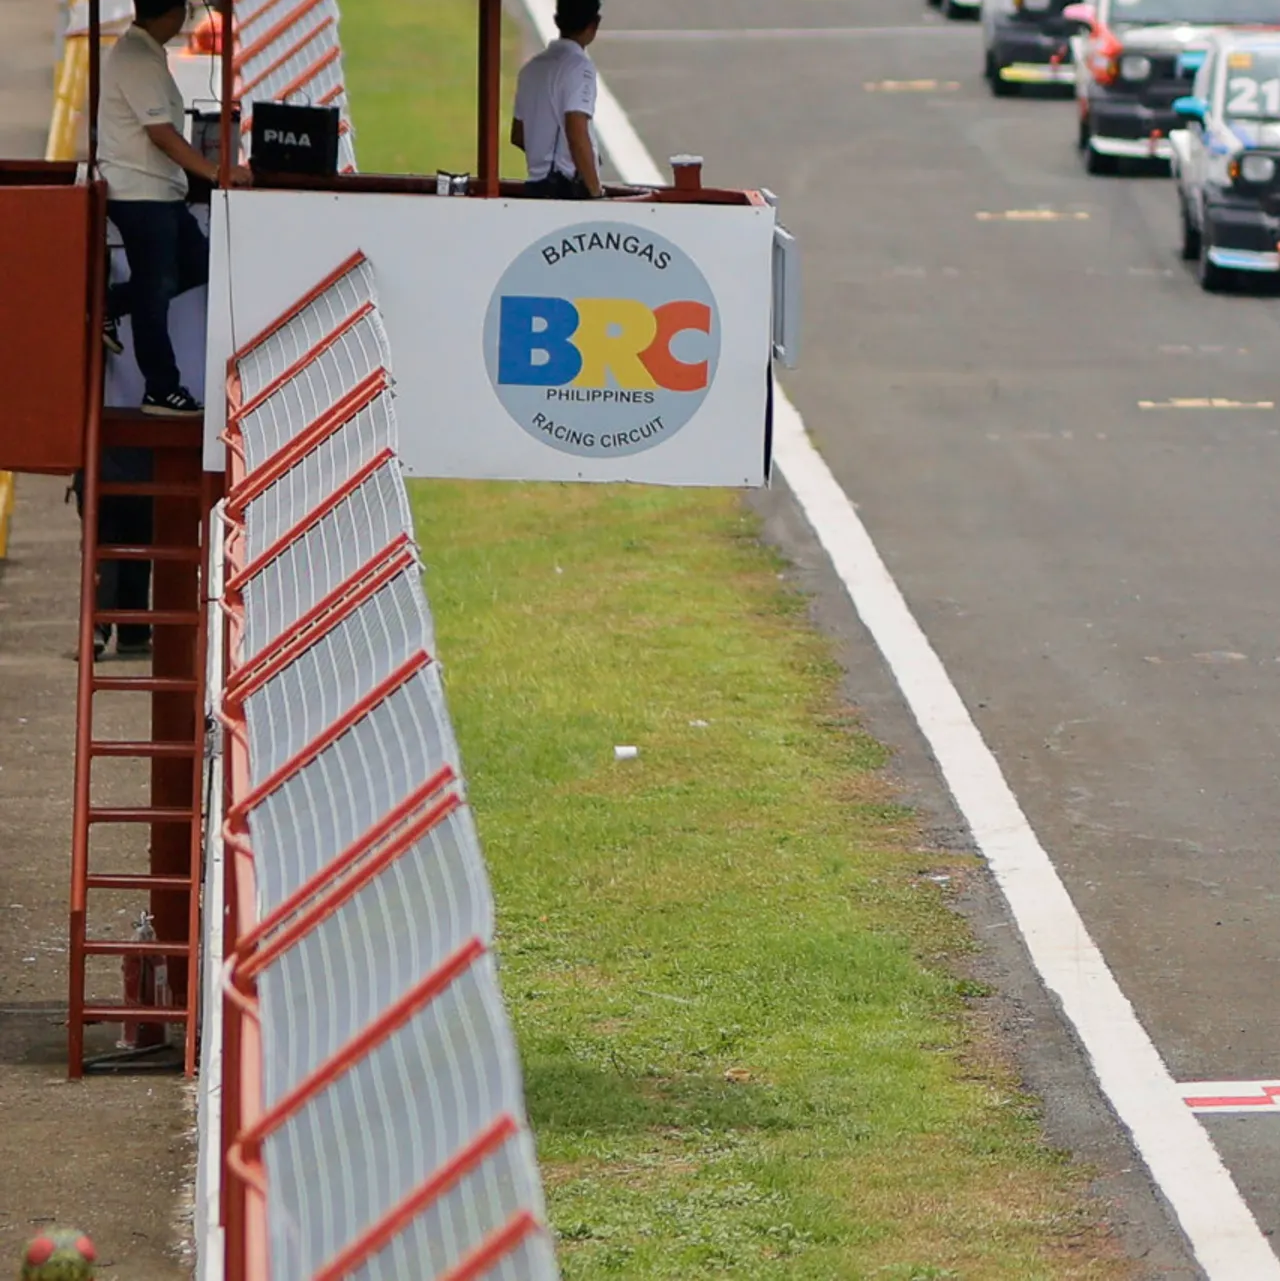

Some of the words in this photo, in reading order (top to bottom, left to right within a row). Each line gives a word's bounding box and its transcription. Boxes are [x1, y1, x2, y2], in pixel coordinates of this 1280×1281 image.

[264, 129, 311, 147] PIAA
[542, 232, 672, 270] BATANGAS
[498, 295, 711, 392] BRC
[546, 388, 655, 404] PHILIPPINES
[532, 412, 596, 448] RACING
[600, 416, 665, 449] CIRCUIT
